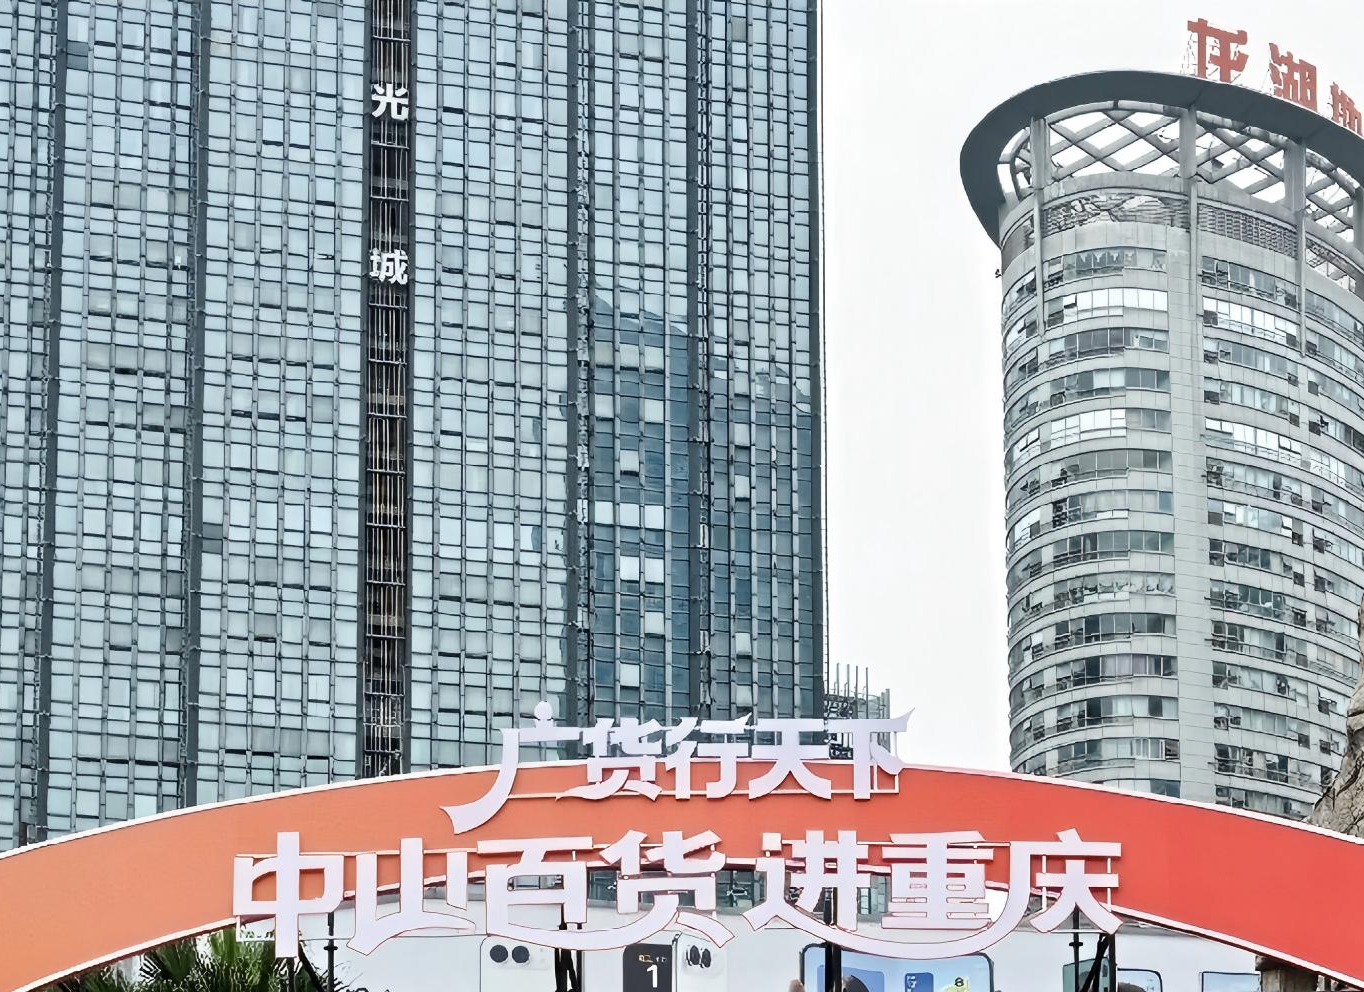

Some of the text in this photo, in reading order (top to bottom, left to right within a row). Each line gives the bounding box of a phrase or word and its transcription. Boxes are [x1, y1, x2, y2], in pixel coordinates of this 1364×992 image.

[370, 83, 410, 286] 光城
[441, 702, 914, 834] 广货行天下
[234, 829, 1123, 958] 中山百货进重庆
[646, 964, 658, 988] 1
